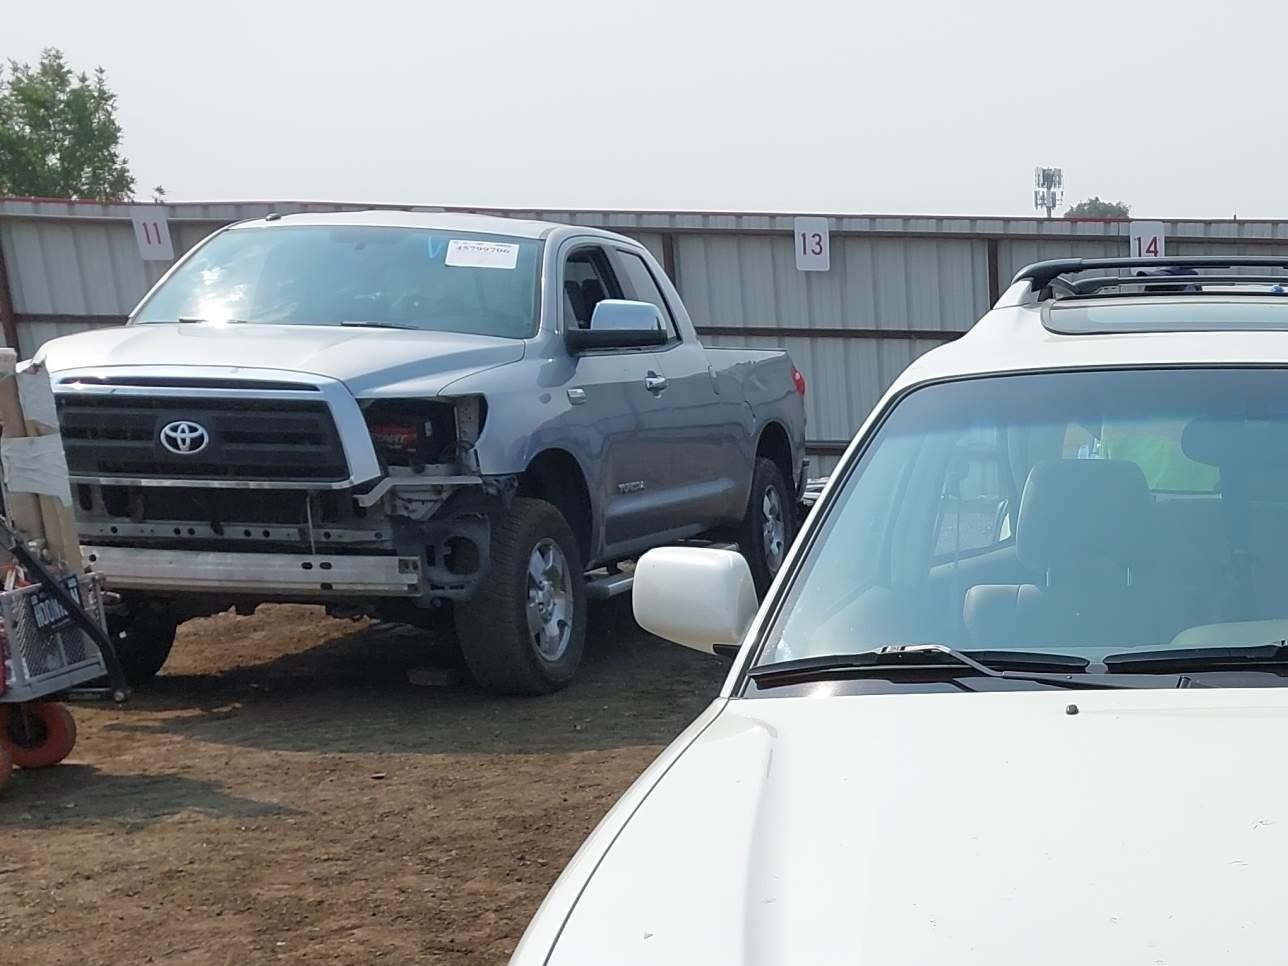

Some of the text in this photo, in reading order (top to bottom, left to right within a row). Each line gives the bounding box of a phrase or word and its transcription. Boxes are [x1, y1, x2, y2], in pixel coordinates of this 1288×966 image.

[142, 222, 161, 245] 11
[801, 233, 823, 255] 13
[1134, 236, 1159, 257] 14
